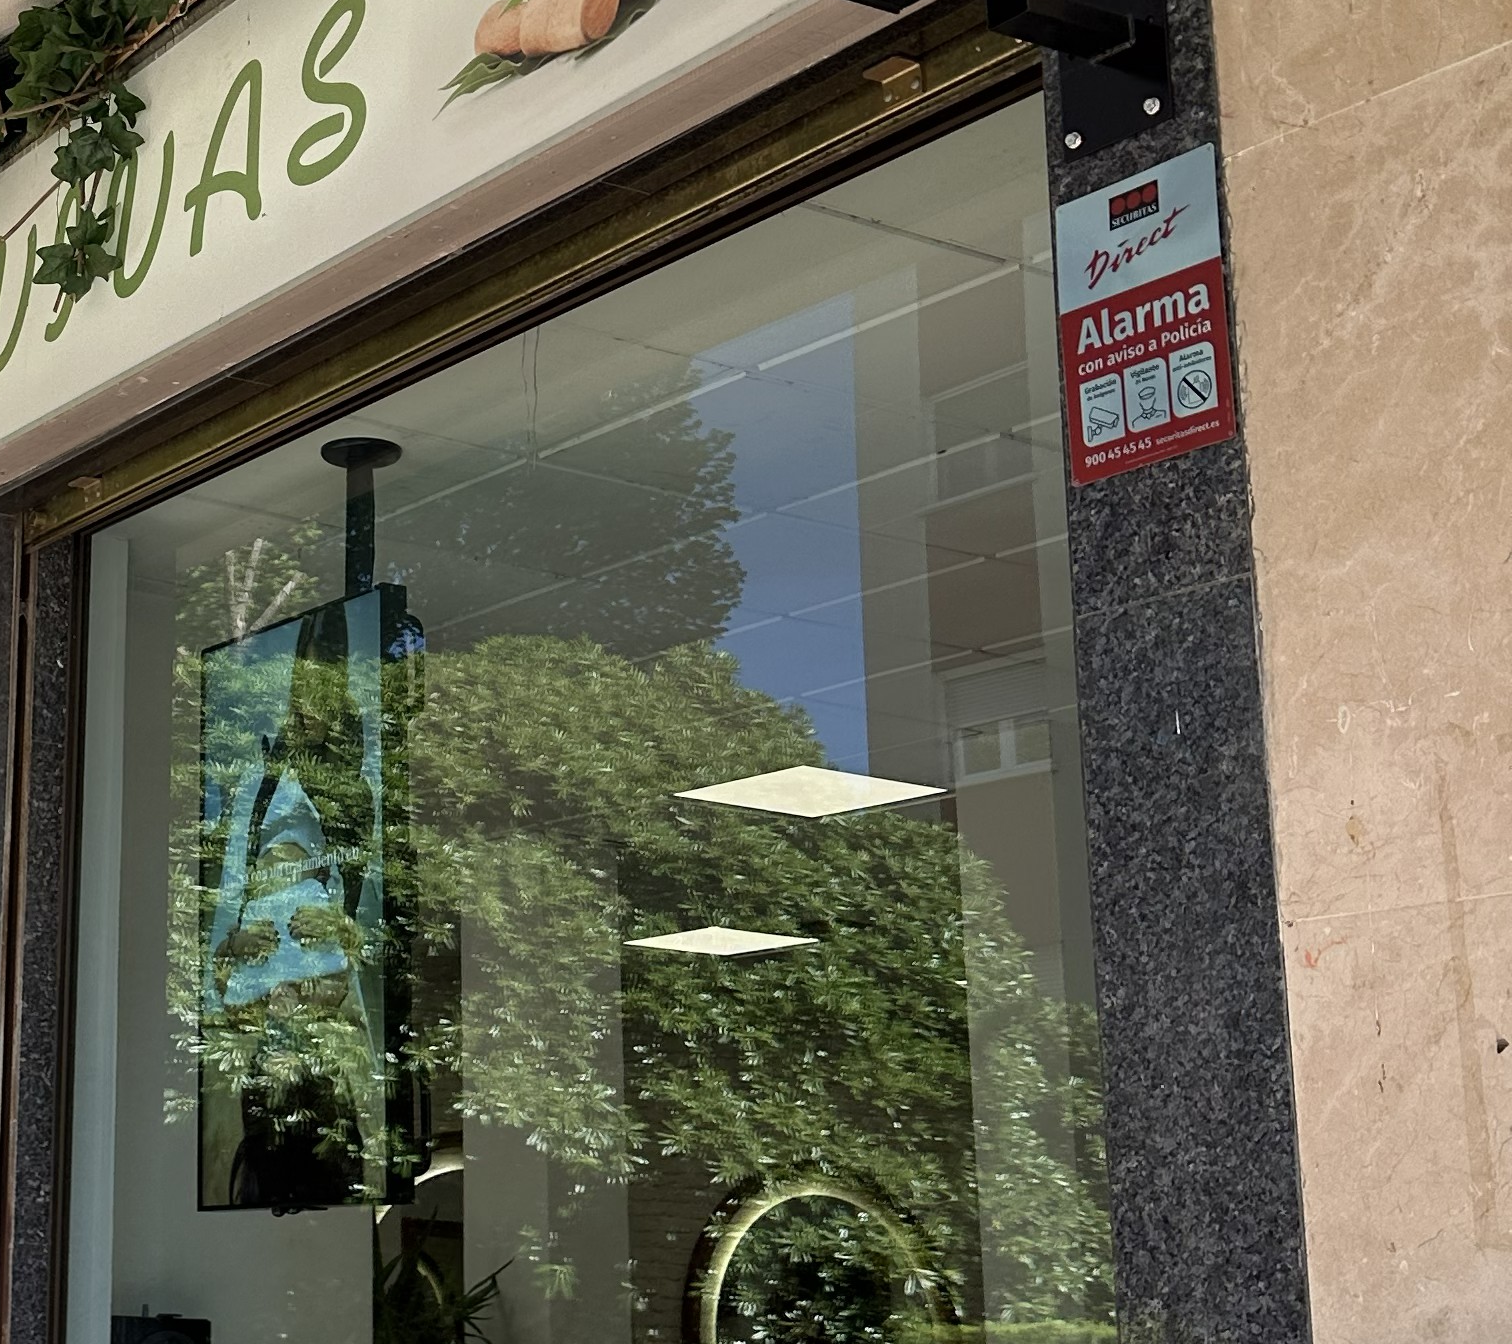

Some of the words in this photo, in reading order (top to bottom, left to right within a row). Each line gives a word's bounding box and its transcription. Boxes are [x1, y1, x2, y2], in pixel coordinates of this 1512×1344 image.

[1111, 202, 1158, 228] SECURITAS
[1083, 203, 1191, 290] Direct
[1077, 283, 1210, 355] Alarma
[1078, 358, 1103, 375] con
[1107, 343, 1145, 366] aviso
[1148, 339, 1158, 352] a
[1161, 318, 1212, 347] Policía
[1084, 451, 1106, 468] 900
[1108, 446, 1122, 460] 45
[1122, 441, 1137, 455] 45
[1138, 436, 1152, 450] 45
